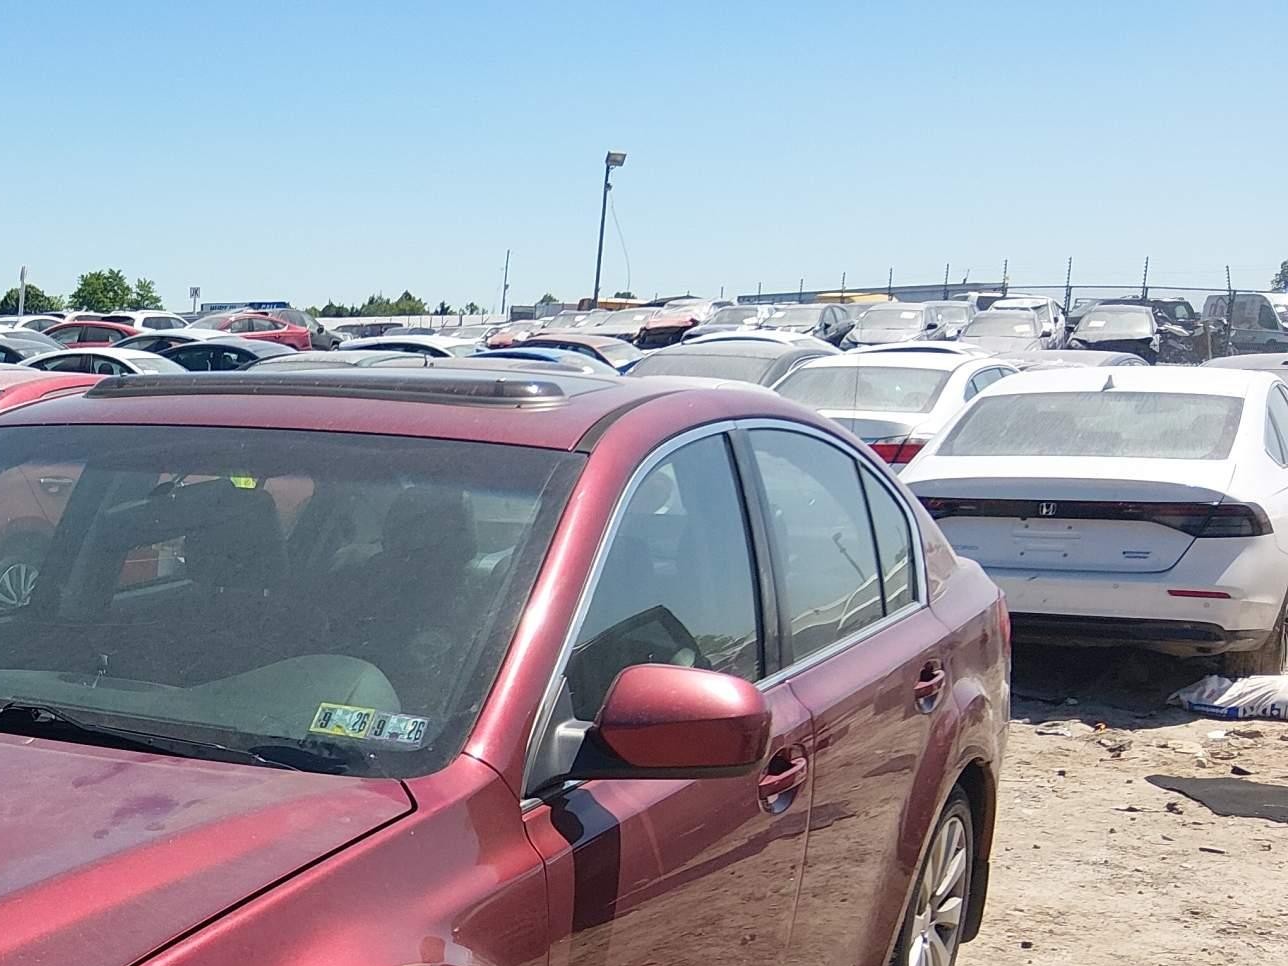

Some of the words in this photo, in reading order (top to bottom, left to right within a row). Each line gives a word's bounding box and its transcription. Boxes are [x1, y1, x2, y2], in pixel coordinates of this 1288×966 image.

[319, 711, 332, 729] 9
[351, 711, 370, 733] 26
[373, 719, 386, 737] 9
[406, 720, 425, 741] 26
